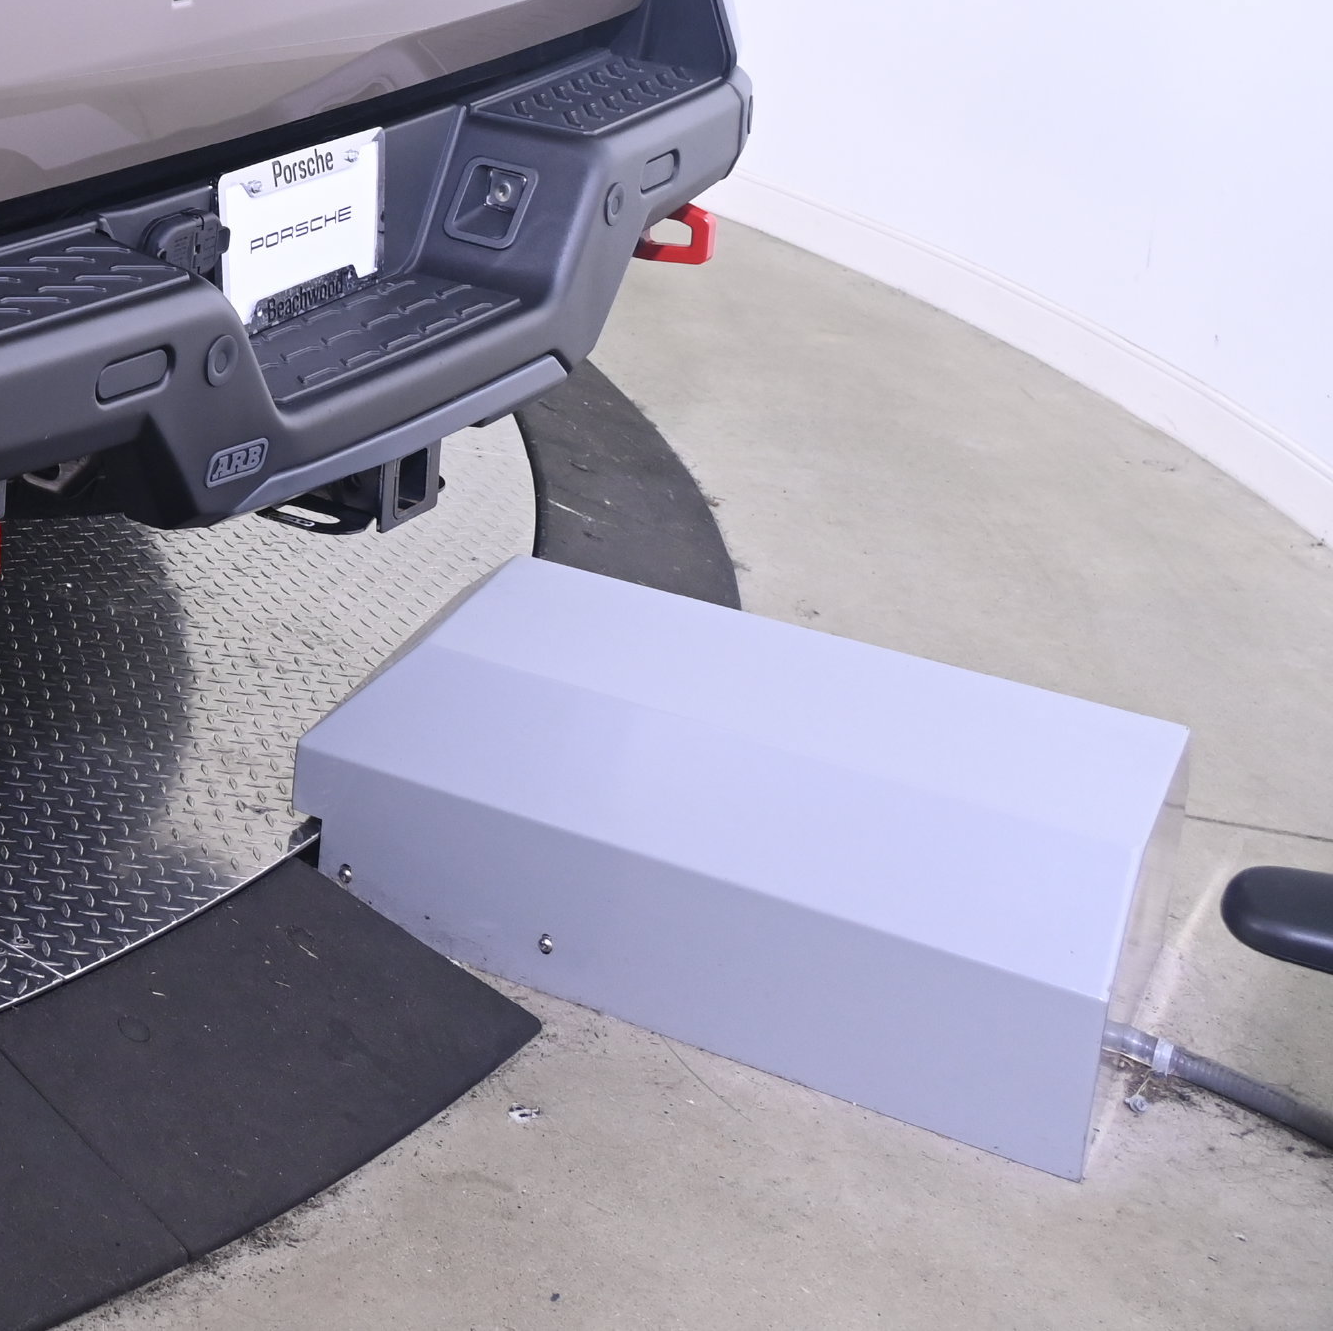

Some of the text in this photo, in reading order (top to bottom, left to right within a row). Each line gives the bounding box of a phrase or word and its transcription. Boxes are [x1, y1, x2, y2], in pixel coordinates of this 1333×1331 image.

[271, 148, 334, 188] Porsche
[249, 205, 352, 254] PORSCHE
[266, 274, 343, 321] Beachwood
[211, 445, 262, 481] ARB
